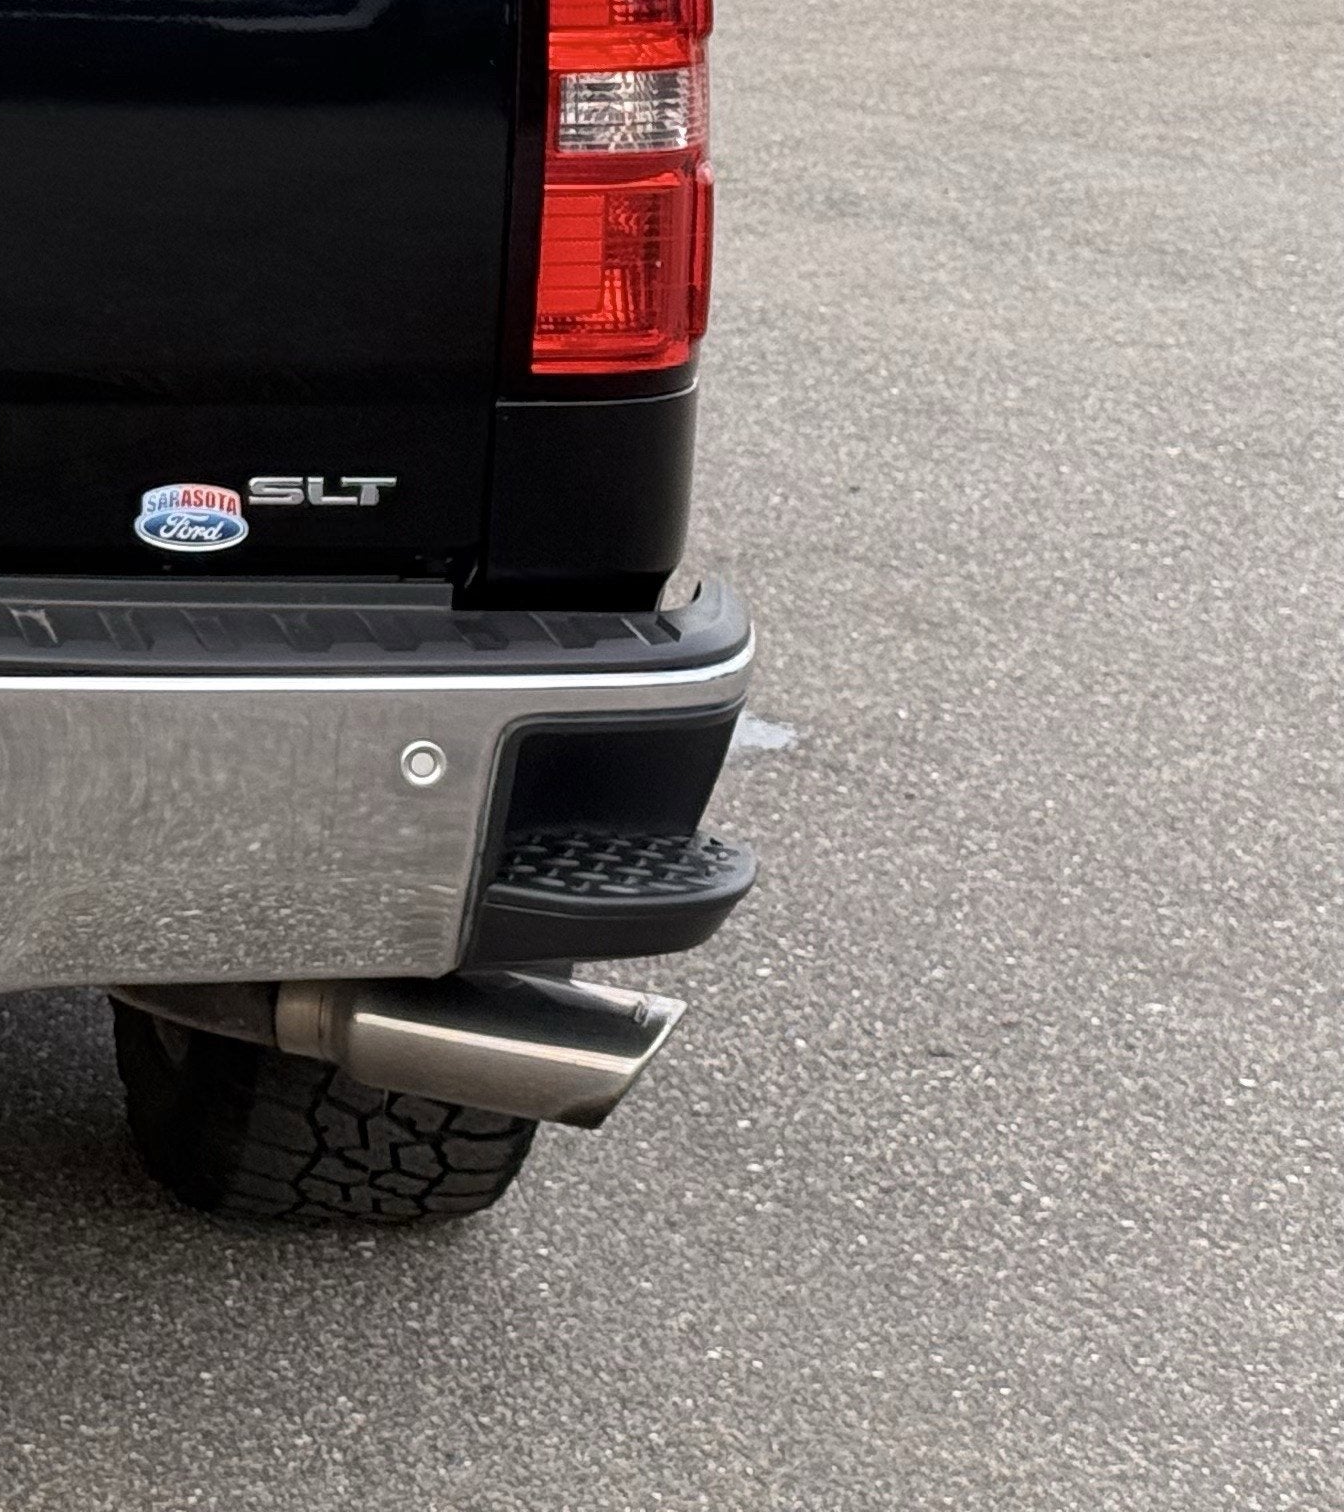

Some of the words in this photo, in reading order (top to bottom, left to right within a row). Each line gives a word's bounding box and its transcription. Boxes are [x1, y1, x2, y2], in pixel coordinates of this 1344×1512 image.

[146, 487, 238, 516] SARASOTA
[248, 476, 397, 506] SLT
[159, 512, 223, 541] Ford
